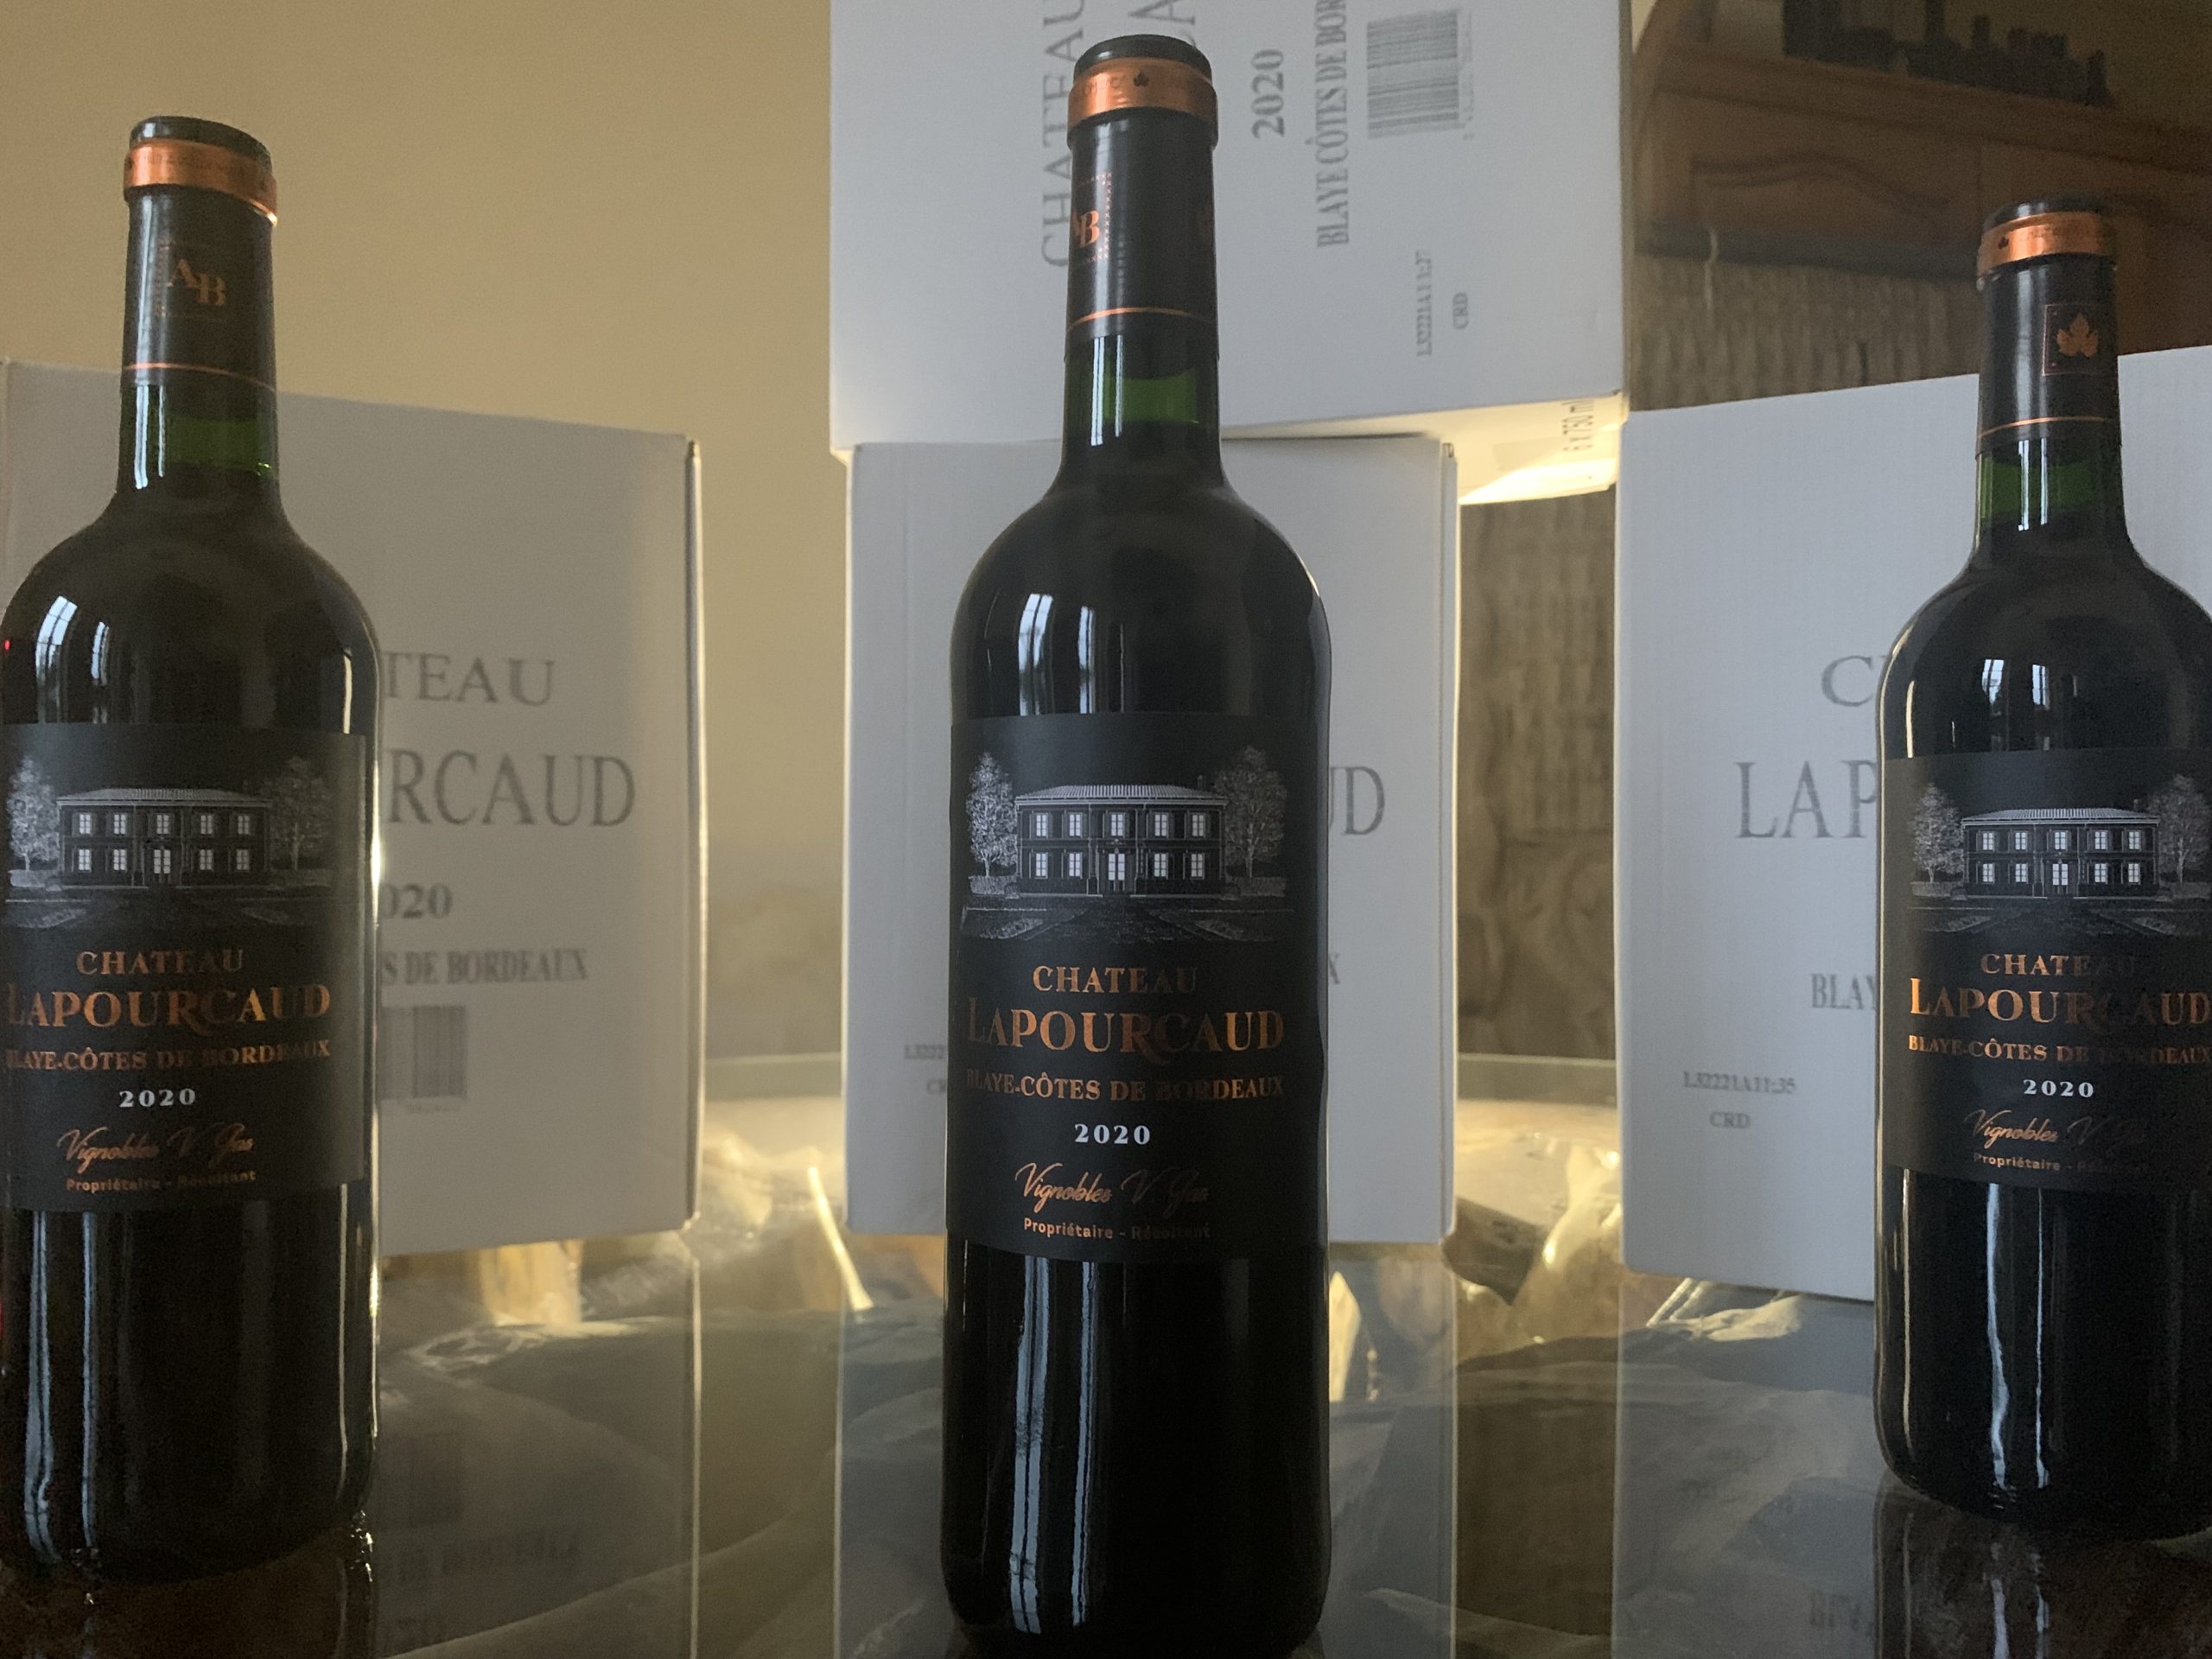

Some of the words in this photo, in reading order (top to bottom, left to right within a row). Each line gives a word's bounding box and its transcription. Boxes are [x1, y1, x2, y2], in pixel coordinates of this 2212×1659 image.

[1314, 49, 1348, 84] DE
[1250, 48, 1286, 139] 2020
[1303, 87, 1350, 166] CÔTES
[1315, 169, 1351, 249] BLAYE
[387, 747, 637, 828] RCAUD
[76, 950, 244, 975] CHATEAU
[446, 948, 588, 984] BORDEAUX
[1032, 965, 1198, 994] CHATEAU
[6, 982, 331, 1036] LAPOURCAUD
[1910, 977, 2212, 1031] LAPOURAUD
[967, 996, 1285, 1065] LAPOURCAUD
[156, 1049, 193, 1070] DE
[2056, 1045, 2090, 1063] DE
[118, 1088, 197, 1108] 2020
[1110, 1079, 1147, 1102] DE
[1155, 1076, 1285, 1102] BORDEAUX
[2023, 1079, 2095, 1098] 2020
[1074, 1123, 1152, 1146] 2020
[1963, 1109, 2060, 1149] Vignobles
[55, 1125, 160, 1174] Vignobles
[1974, 1153, 2062, 1172] Propriétaire
[1014, 1162, 1113, 1213] Vignobles
[1023, 1217, 1114, 1240] Propriétaire
